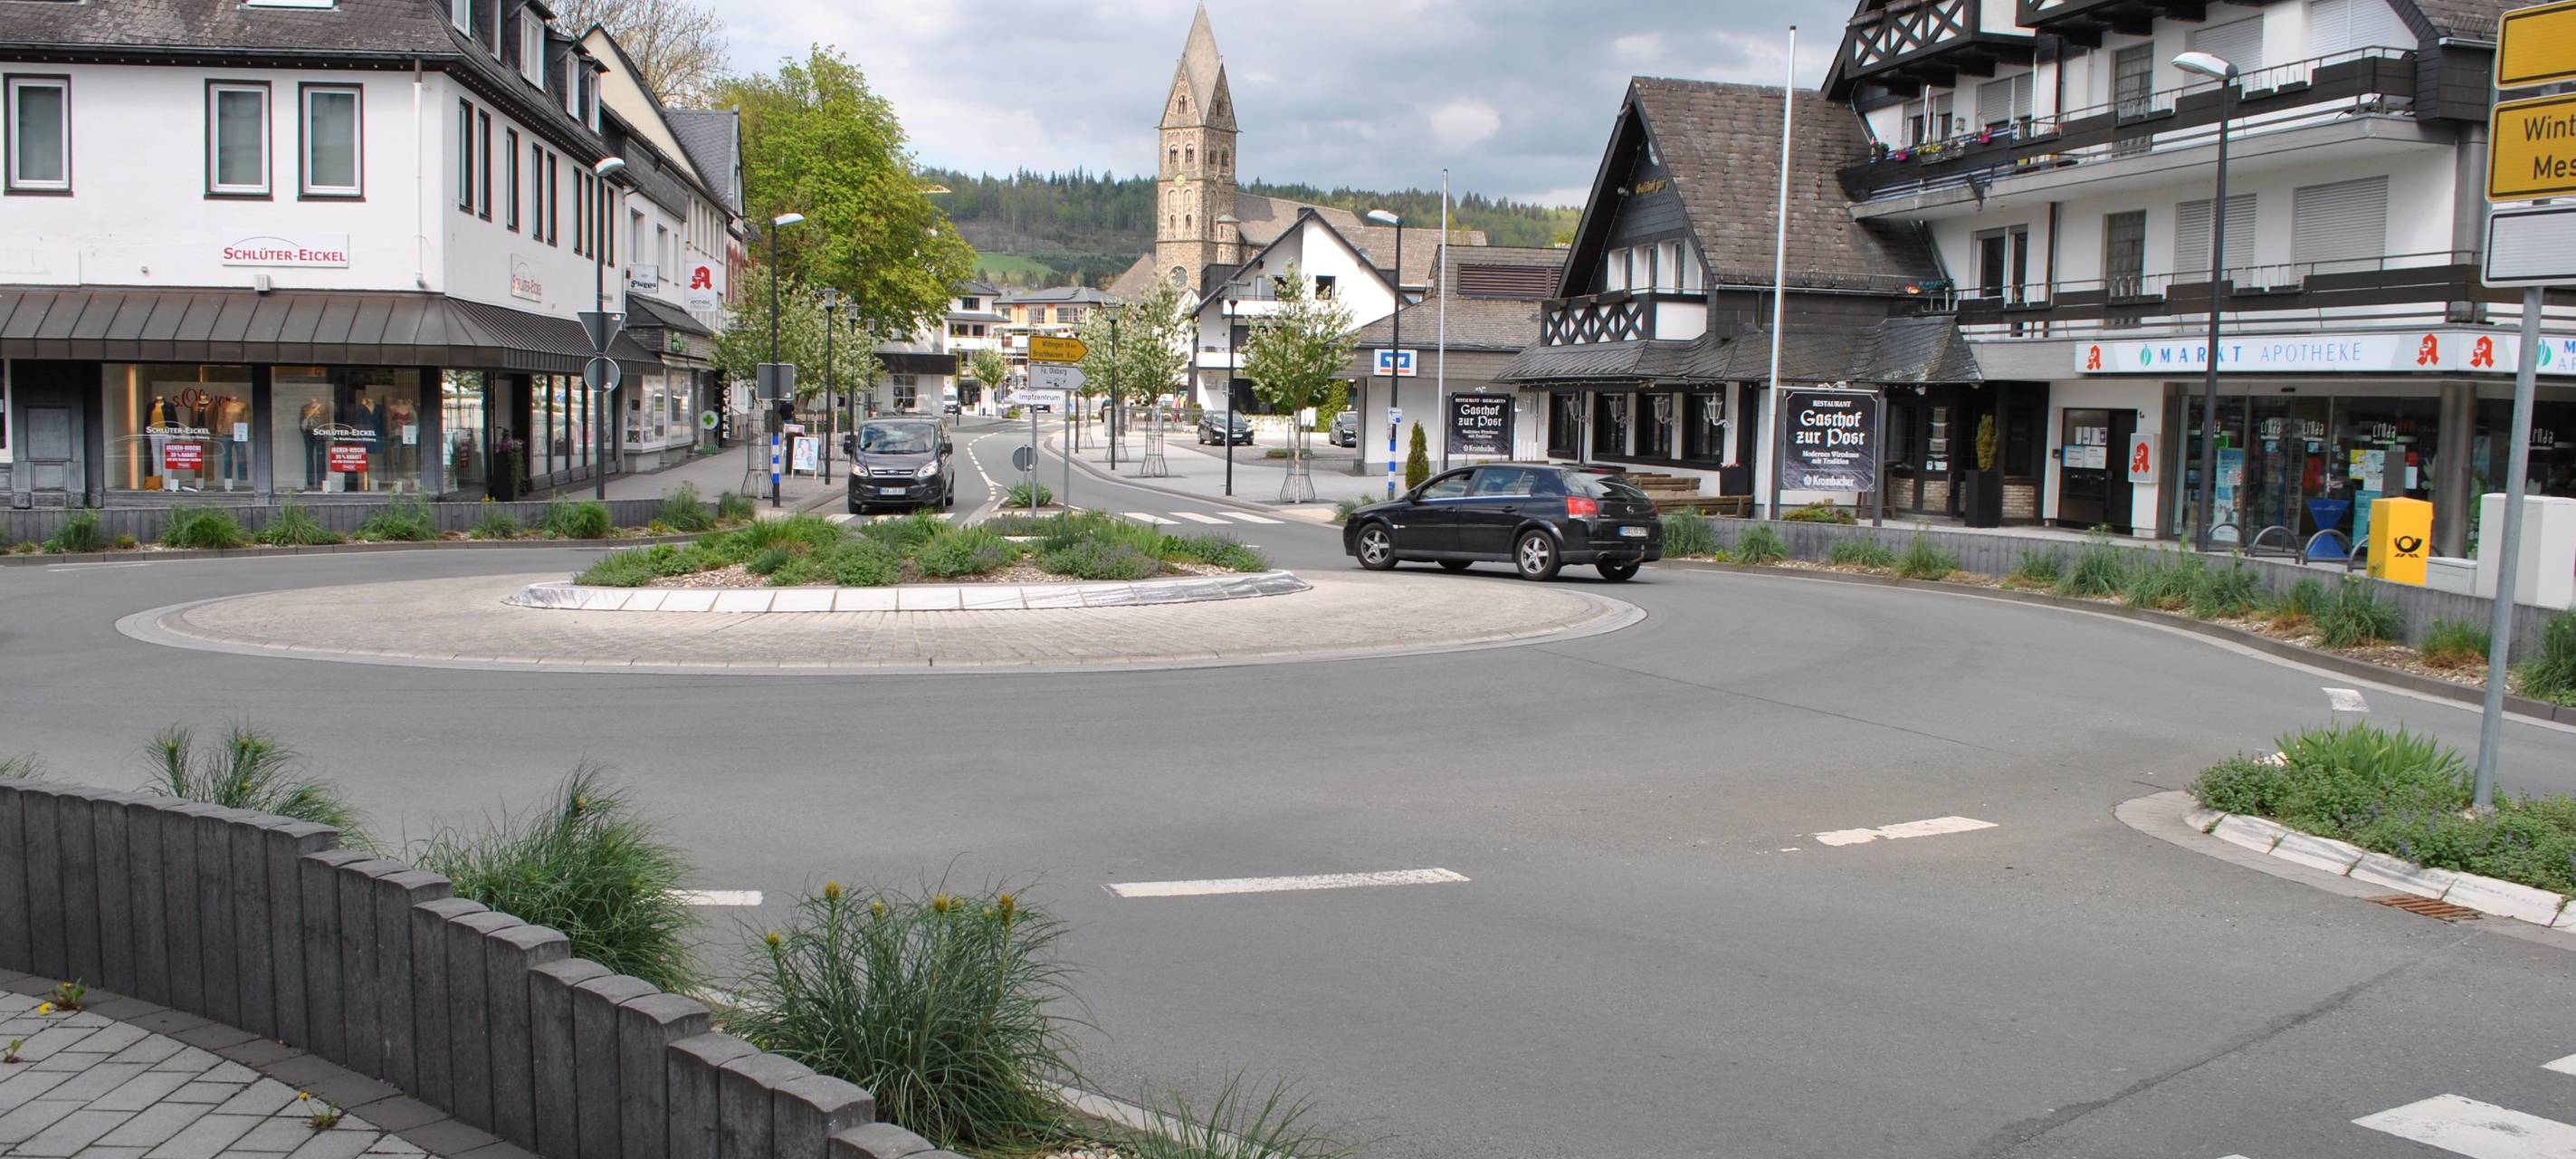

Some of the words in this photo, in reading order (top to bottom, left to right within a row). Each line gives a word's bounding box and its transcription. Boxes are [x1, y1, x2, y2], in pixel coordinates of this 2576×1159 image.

[2524, 114, 2576, 142] Wint
[2533, 154, 2576, 180] Mes
[224, 246, 347, 262] SCHLÜTER-EICKEL
[2160, 346, 2242, 363] MARKT
[2261, 342, 2361, 363] APOTHEKE
[1048, 367, 1068, 376] Olsberg
[1019, 393, 1060, 401] Impfzentrum
[1460, 405, 1501, 417] Gasthof
[1799, 409, 1863, 428] Gasthof
[1457, 417, 1477, 426] zur
[1477, 416, 1503, 428] Post
[1795, 431, 1821, 445] zur
[1827, 428, 1865, 448] Post
[1812, 474, 1855, 486] Krombacher
